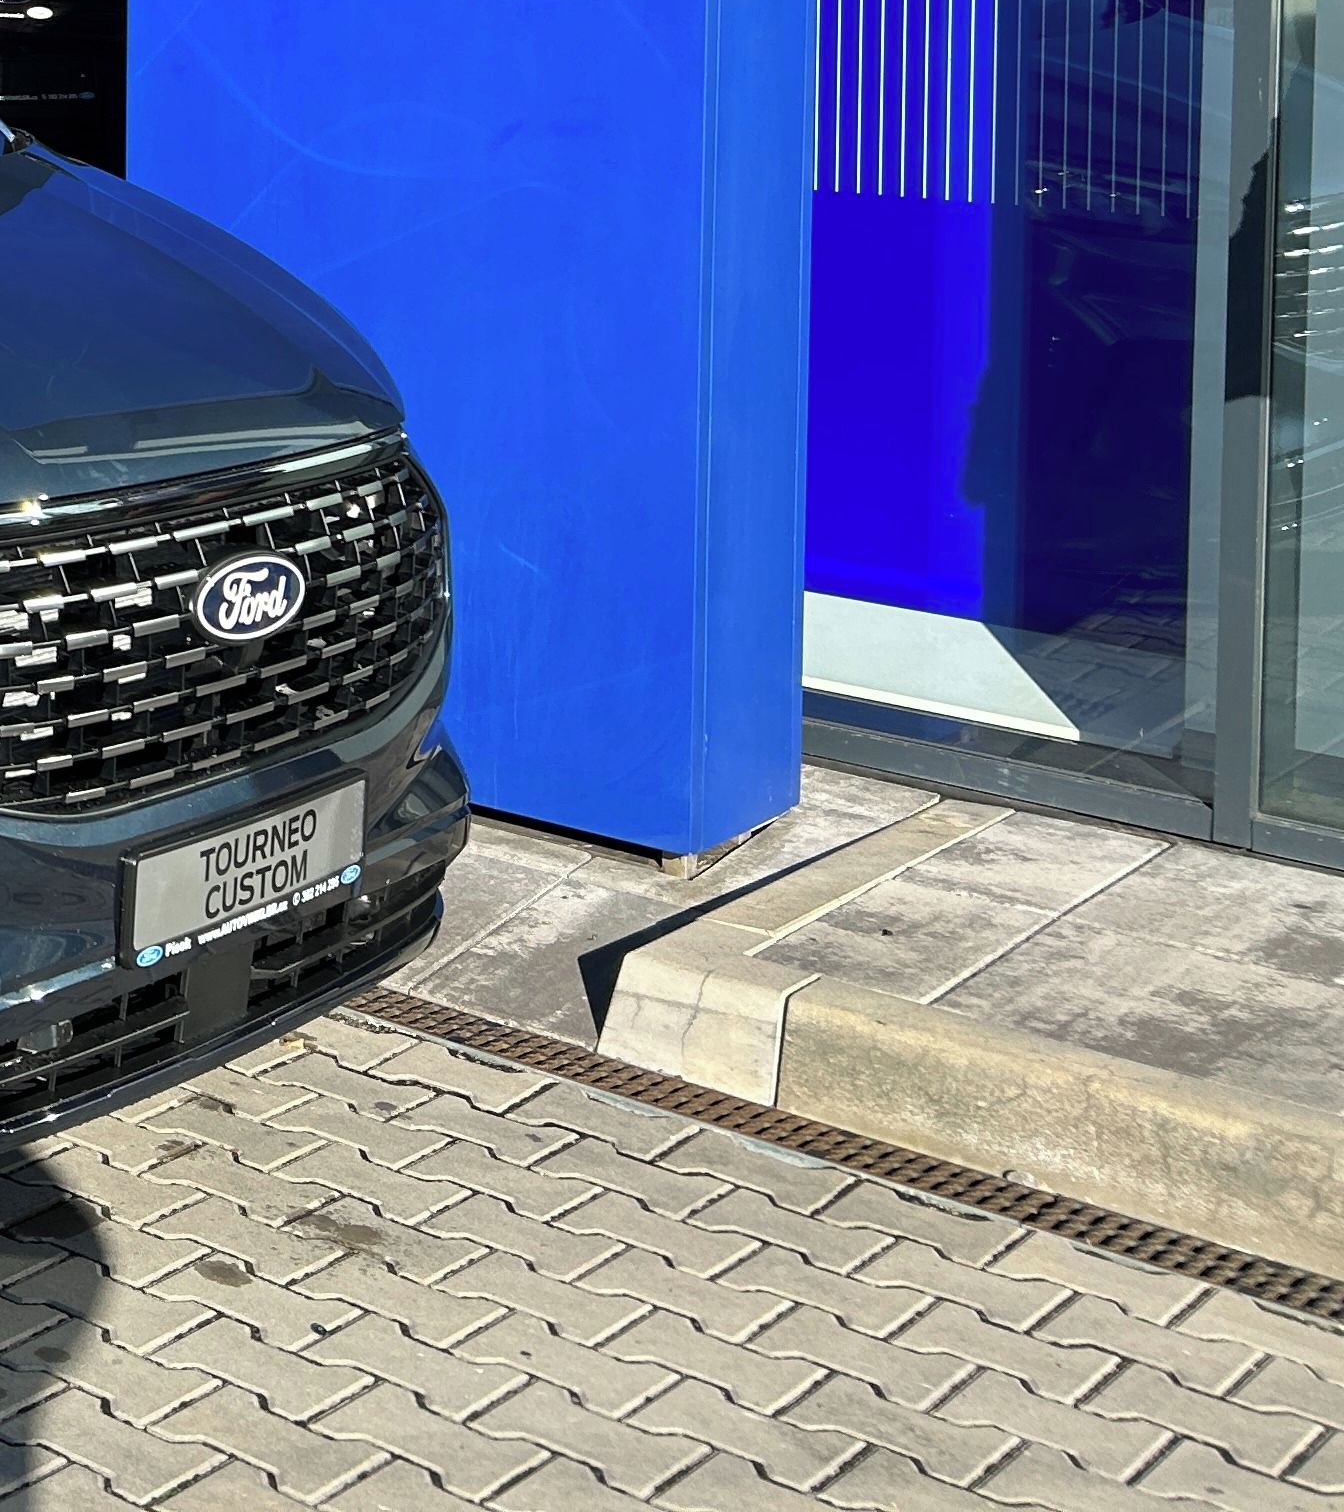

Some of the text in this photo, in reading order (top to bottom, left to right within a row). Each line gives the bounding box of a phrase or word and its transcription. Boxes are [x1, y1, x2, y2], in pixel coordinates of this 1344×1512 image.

[218, 568, 288, 630] Ford
[200, 809, 317, 881] TOURNEO
[205, 849, 308, 919] CUSTOM
